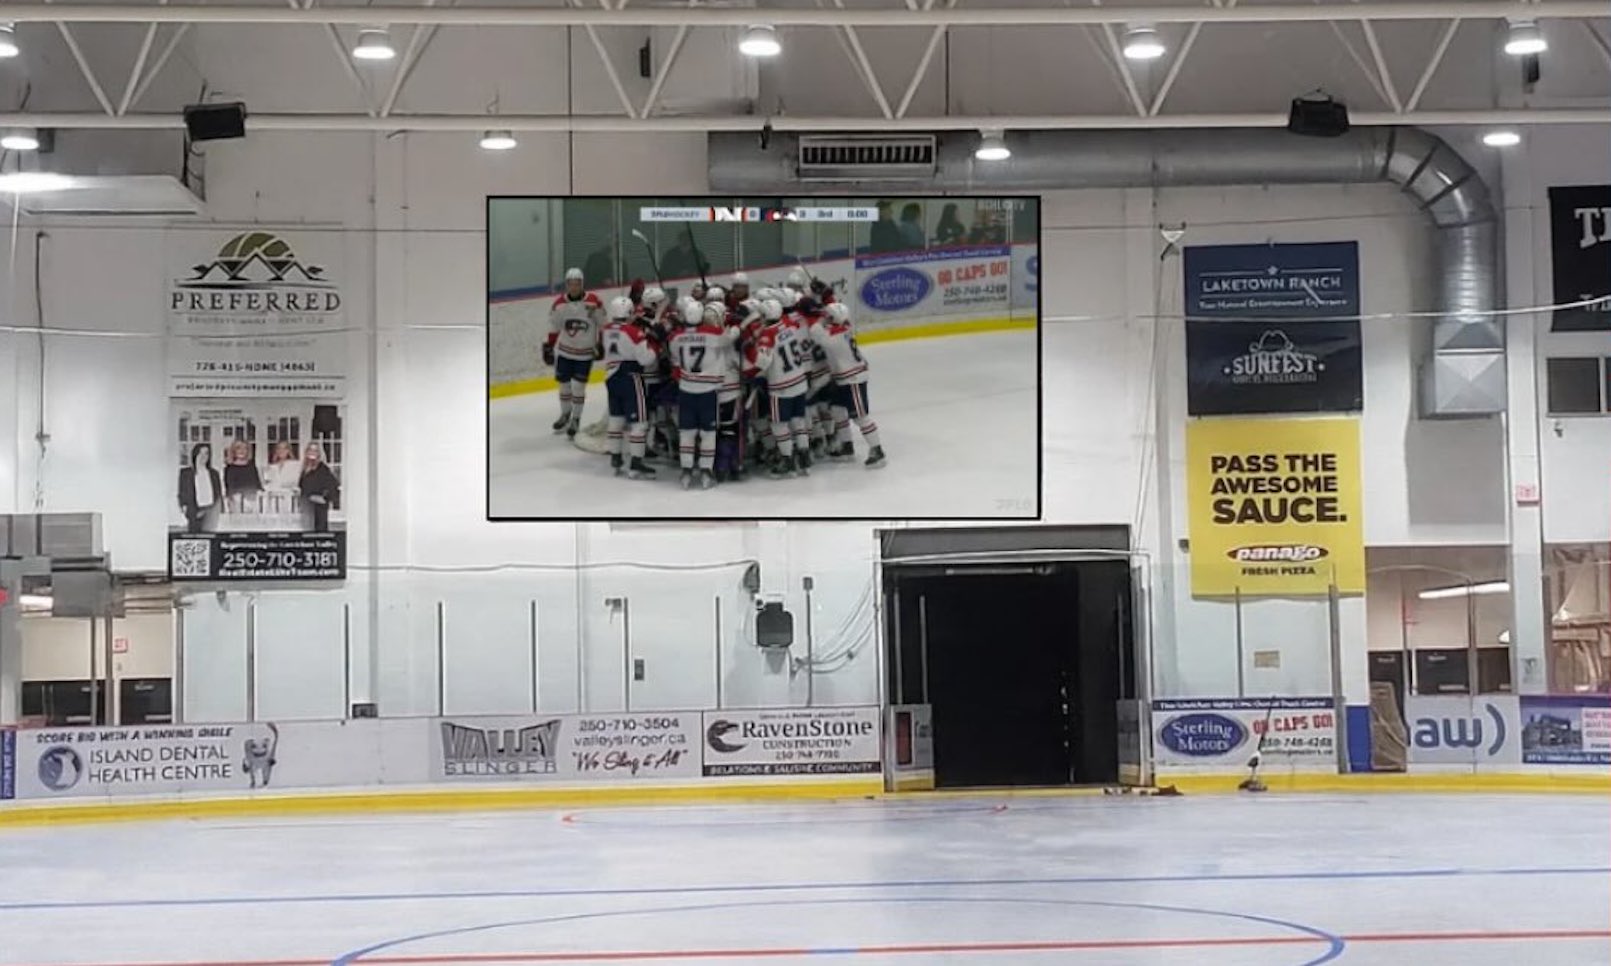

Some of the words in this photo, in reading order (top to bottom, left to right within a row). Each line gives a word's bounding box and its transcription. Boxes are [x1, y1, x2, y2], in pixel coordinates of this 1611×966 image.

[955, 263, 986, 281] CAPS
[870, 273, 921, 291] Sterling
[1202, 278, 1285, 293] LAKETOWN
[1289, 276, 1341, 291] RANCH
[171, 291, 341, 312] PREFERRED
[679, 344, 707, 373] 17
[1232, 349, 1318, 376] SUNFEST
[1210, 454, 1279, 475] PASS
[1284, 453, 1337, 473] THE
[1210, 475, 1338, 496] AWESOME
[1212, 496, 1348, 525] SAUCE.
[223, 551, 338, 568] 250-710-3181
[1235, 545, 1321, 562] panago
[1241, 566, 1279, 576] FRESH
[1281, 565, 1316, 575] PIZZA
[579, 718, 680, 732] 250-710-3504
[741, 720, 873, 739] RavenStone
[1171, 720, 1233, 739] Sterling
[1274, 716, 1309, 732] CAPS
[36, 732, 74, 744] SCORE
[77, 731, 97, 743] BIG
[100, 730, 128, 742] WITH
[131, 730, 142, 741] A
[441, 719, 562, 760] VALLEY
[574, 732, 687, 747] valleyslinger.ca
[763, 738, 852, 750] CONSTRUCTION
[1178, 738, 1230, 752] Motors
[89, 746, 153, 764] ISLAND
[160, 744, 230, 762] DENTAL
[88, 766, 155, 784] HEALTH
[161, 763, 232, 781] CENTRE
[445, 761, 557, 776] SLINGER
